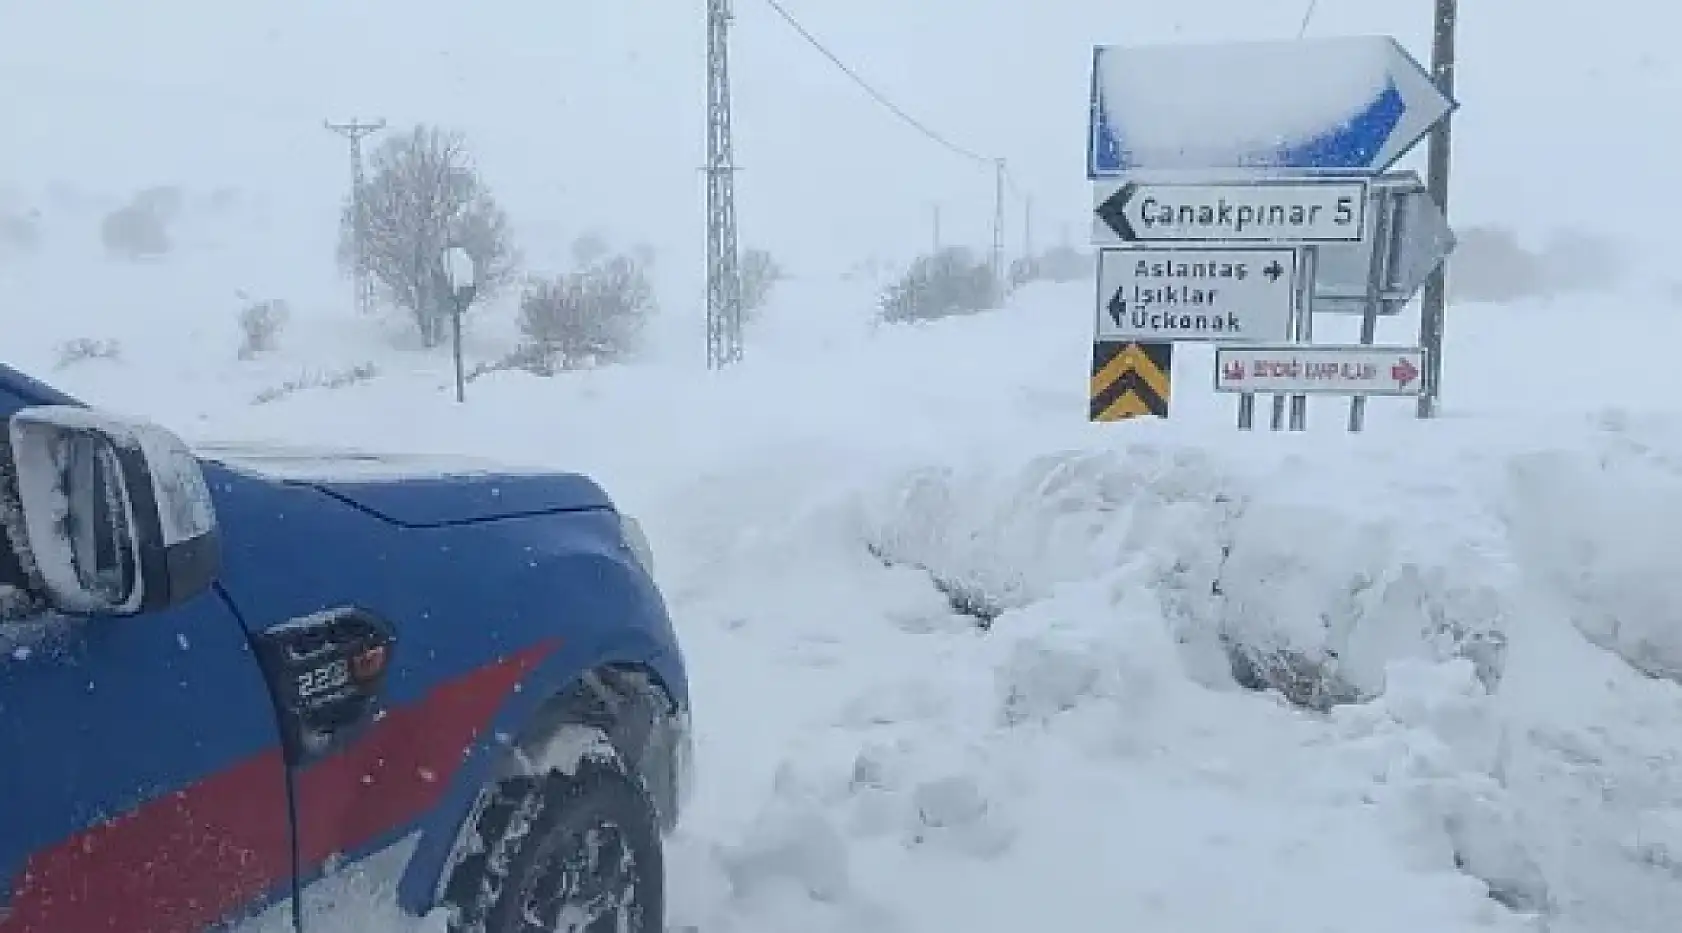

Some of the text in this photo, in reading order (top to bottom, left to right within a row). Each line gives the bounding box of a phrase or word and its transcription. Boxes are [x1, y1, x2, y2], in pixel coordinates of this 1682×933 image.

[1140, 196, 1353, 231] Çanakpınar 5
[1134, 260, 1249, 280] Aslantaş
[1131, 305, 1242, 332] Üçkonak
